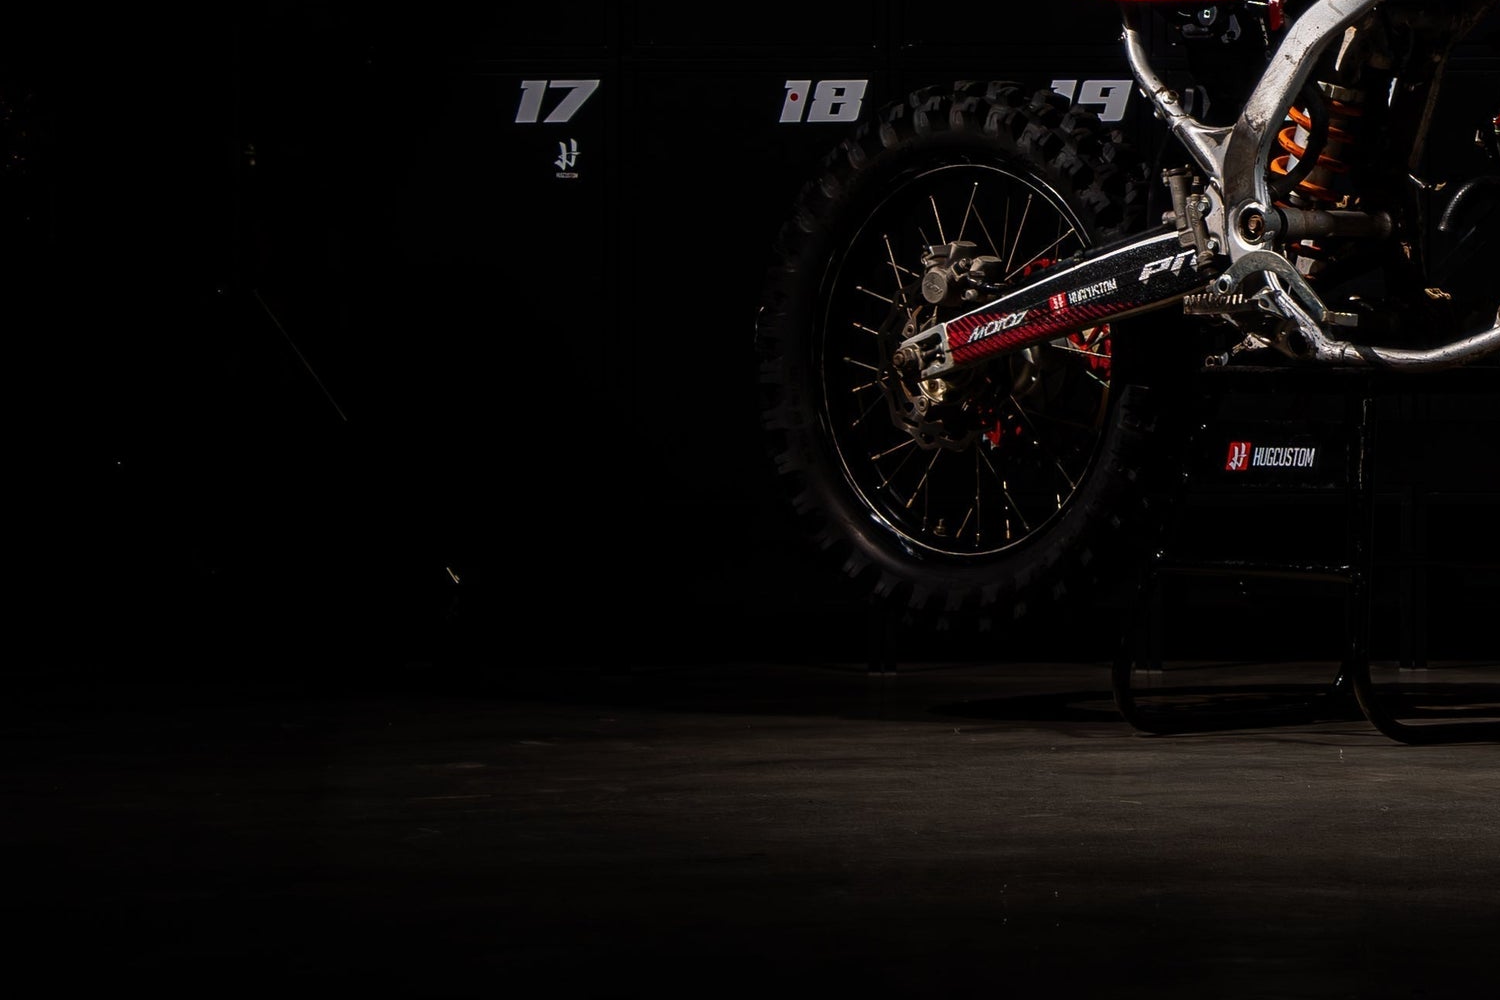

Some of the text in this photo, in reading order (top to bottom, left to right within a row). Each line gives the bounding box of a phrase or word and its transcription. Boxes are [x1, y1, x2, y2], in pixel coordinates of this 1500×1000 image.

[515, 79, 601, 124] 17
[779, 79, 868, 123] 18
[1253, 448, 1315, 467] HUGCUSTOM
